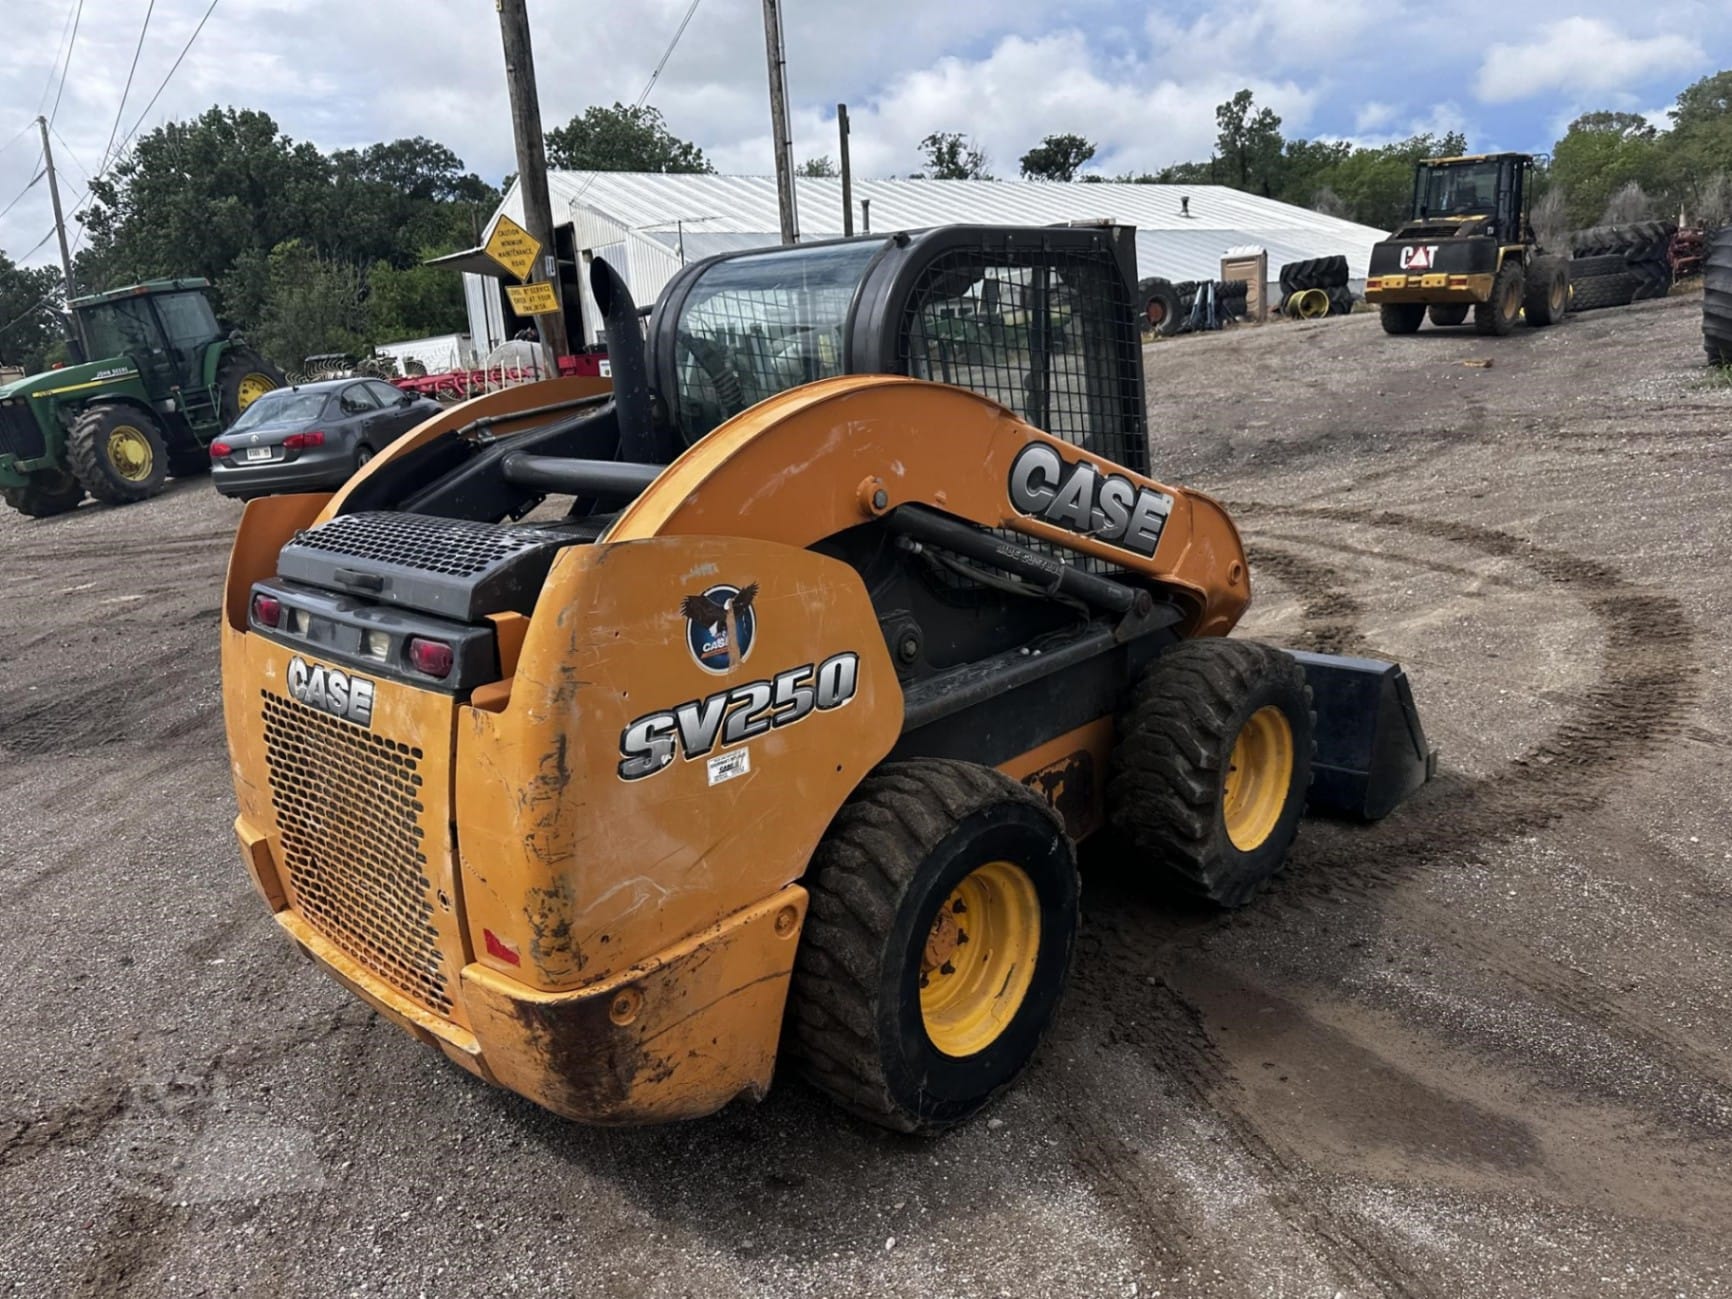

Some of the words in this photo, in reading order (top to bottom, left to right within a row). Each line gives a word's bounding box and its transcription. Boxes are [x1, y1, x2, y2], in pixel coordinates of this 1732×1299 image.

[498, 248, 533, 258] MAINTENANCE
[97, 369, 111, 378] JOHN
[1009, 441, 1174, 559] CASE
[286, 656, 376, 727] CASE
[618, 651, 860, 782] SV250
